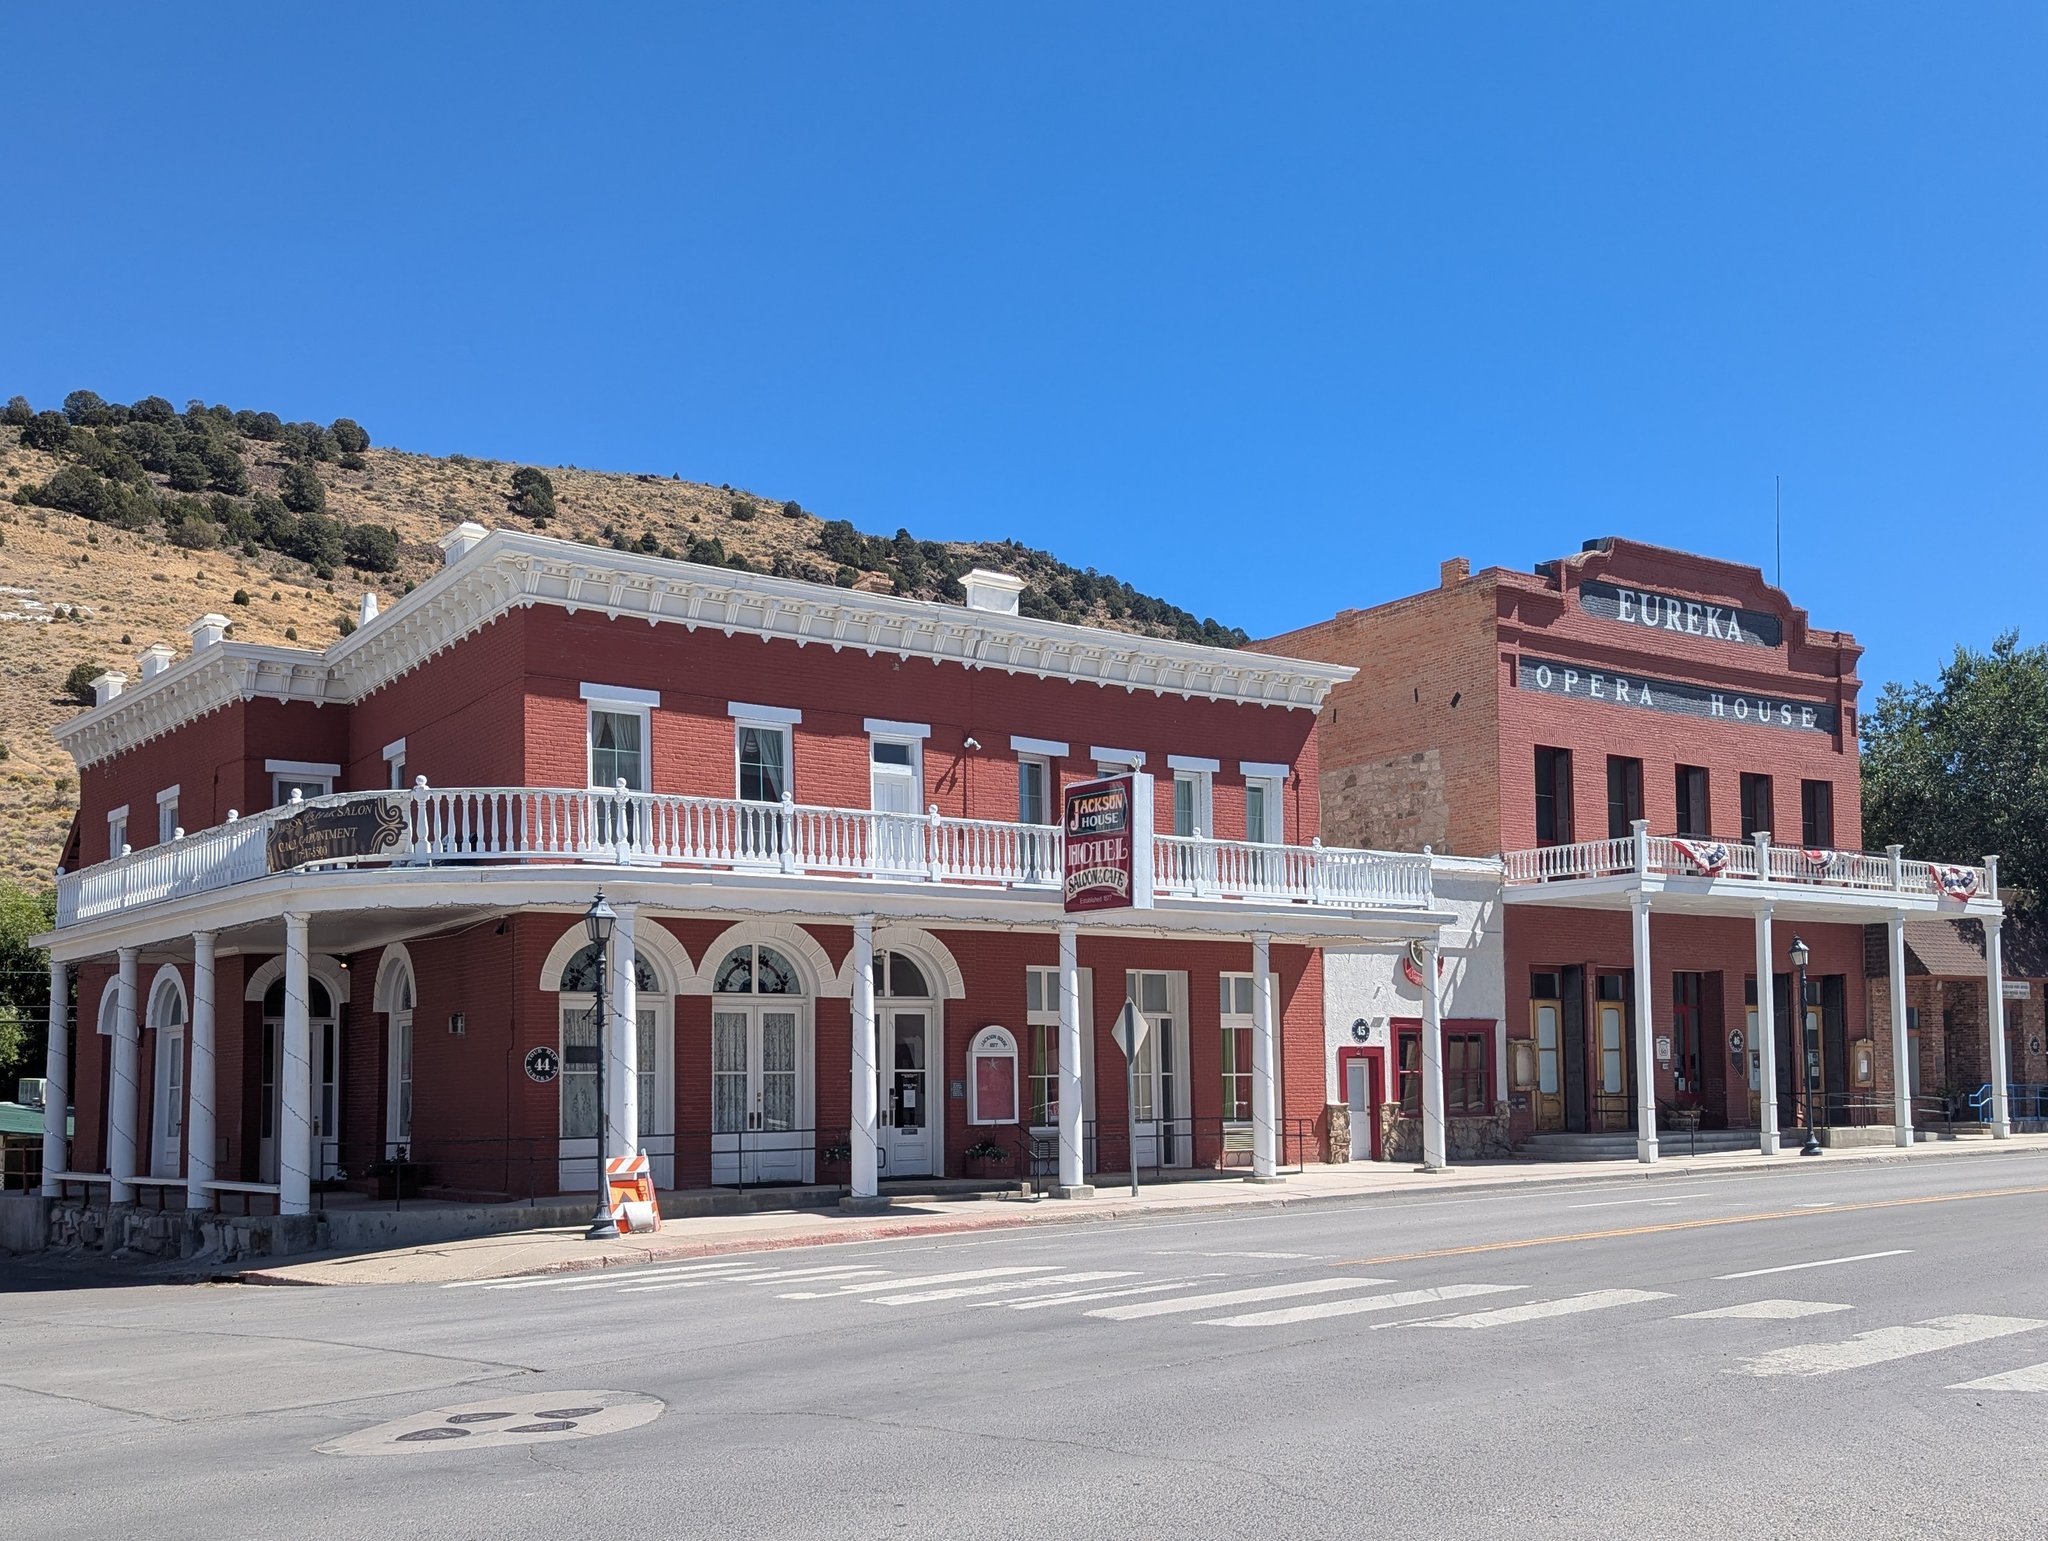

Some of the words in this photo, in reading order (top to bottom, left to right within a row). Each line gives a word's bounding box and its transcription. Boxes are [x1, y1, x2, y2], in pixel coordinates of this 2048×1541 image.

[1616, 588, 1744, 642] EUREKA
[1536, 665, 1653, 705] OPERA
[1710, 693, 1817, 727] HOUSE
[336, 804, 372, 817] SALON
[1070, 793, 1123, 830] JACKSON
[1081, 812, 1119, 828] HOUSE
[1068, 837, 1128, 866] HOTEL
[1068, 870, 1098, 893] SALOON
[1356, 1025, 1366, 1036] 45
[527, 1049, 542, 1060] TOUR
[534, 1057, 551, 1070] 44
